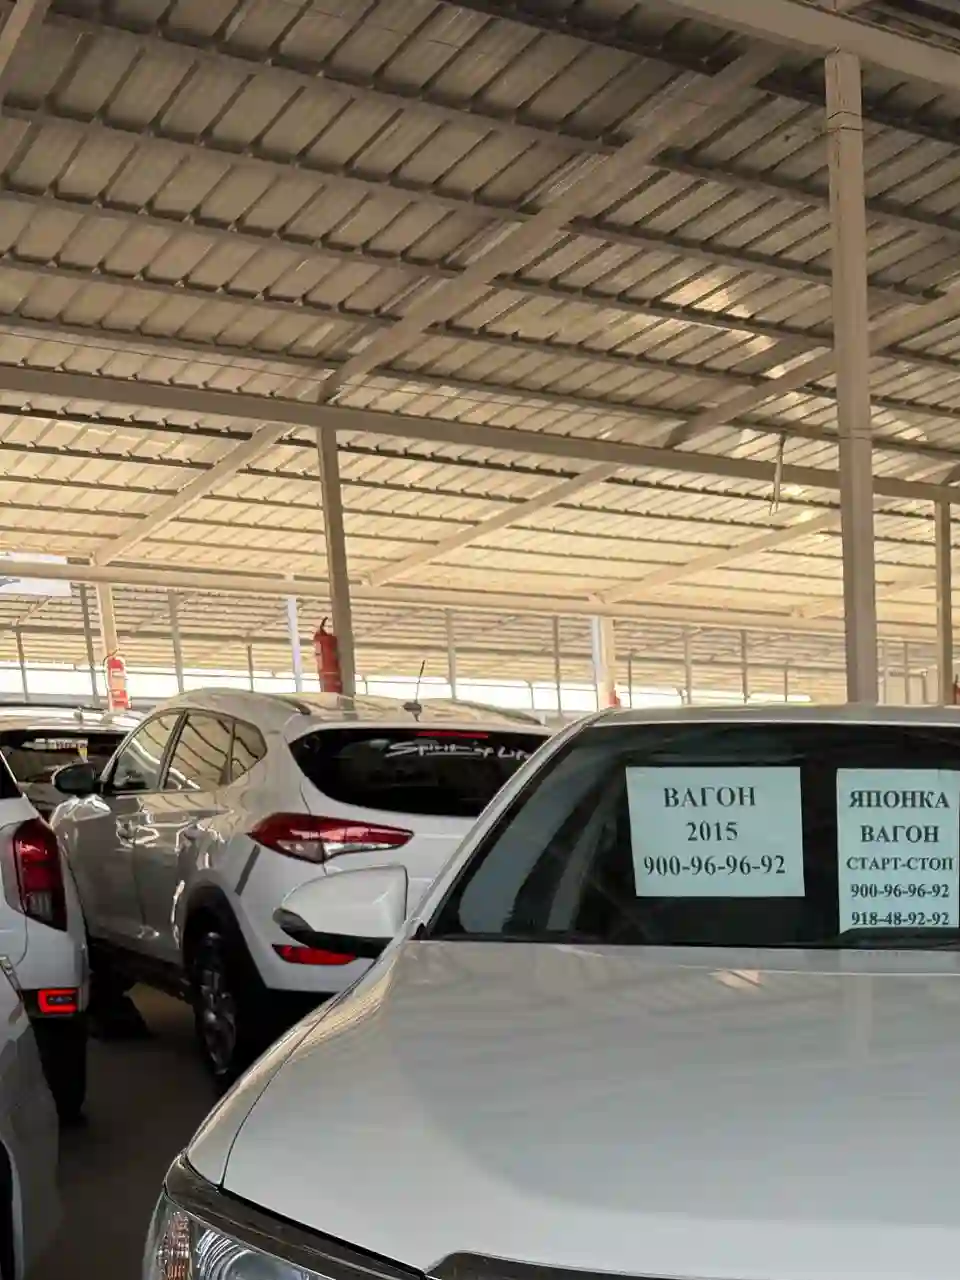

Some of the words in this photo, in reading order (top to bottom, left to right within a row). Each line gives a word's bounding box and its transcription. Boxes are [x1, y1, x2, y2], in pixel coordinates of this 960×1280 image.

[663, 786, 756, 808] ВАГОН
[849, 790, 950, 809] ЯПОНКА
[686, 821, 738, 842] 2015
[860, 825, 939, 844] ВАГОН
[643, 854, 786, 877] 900-96-96-92
[846, 856, 954, 871] СТАРТ-СТОП
[851, 883, 949, 899] 900-96-96-92
[851, 911, 949, 926] 918-48-92-92
